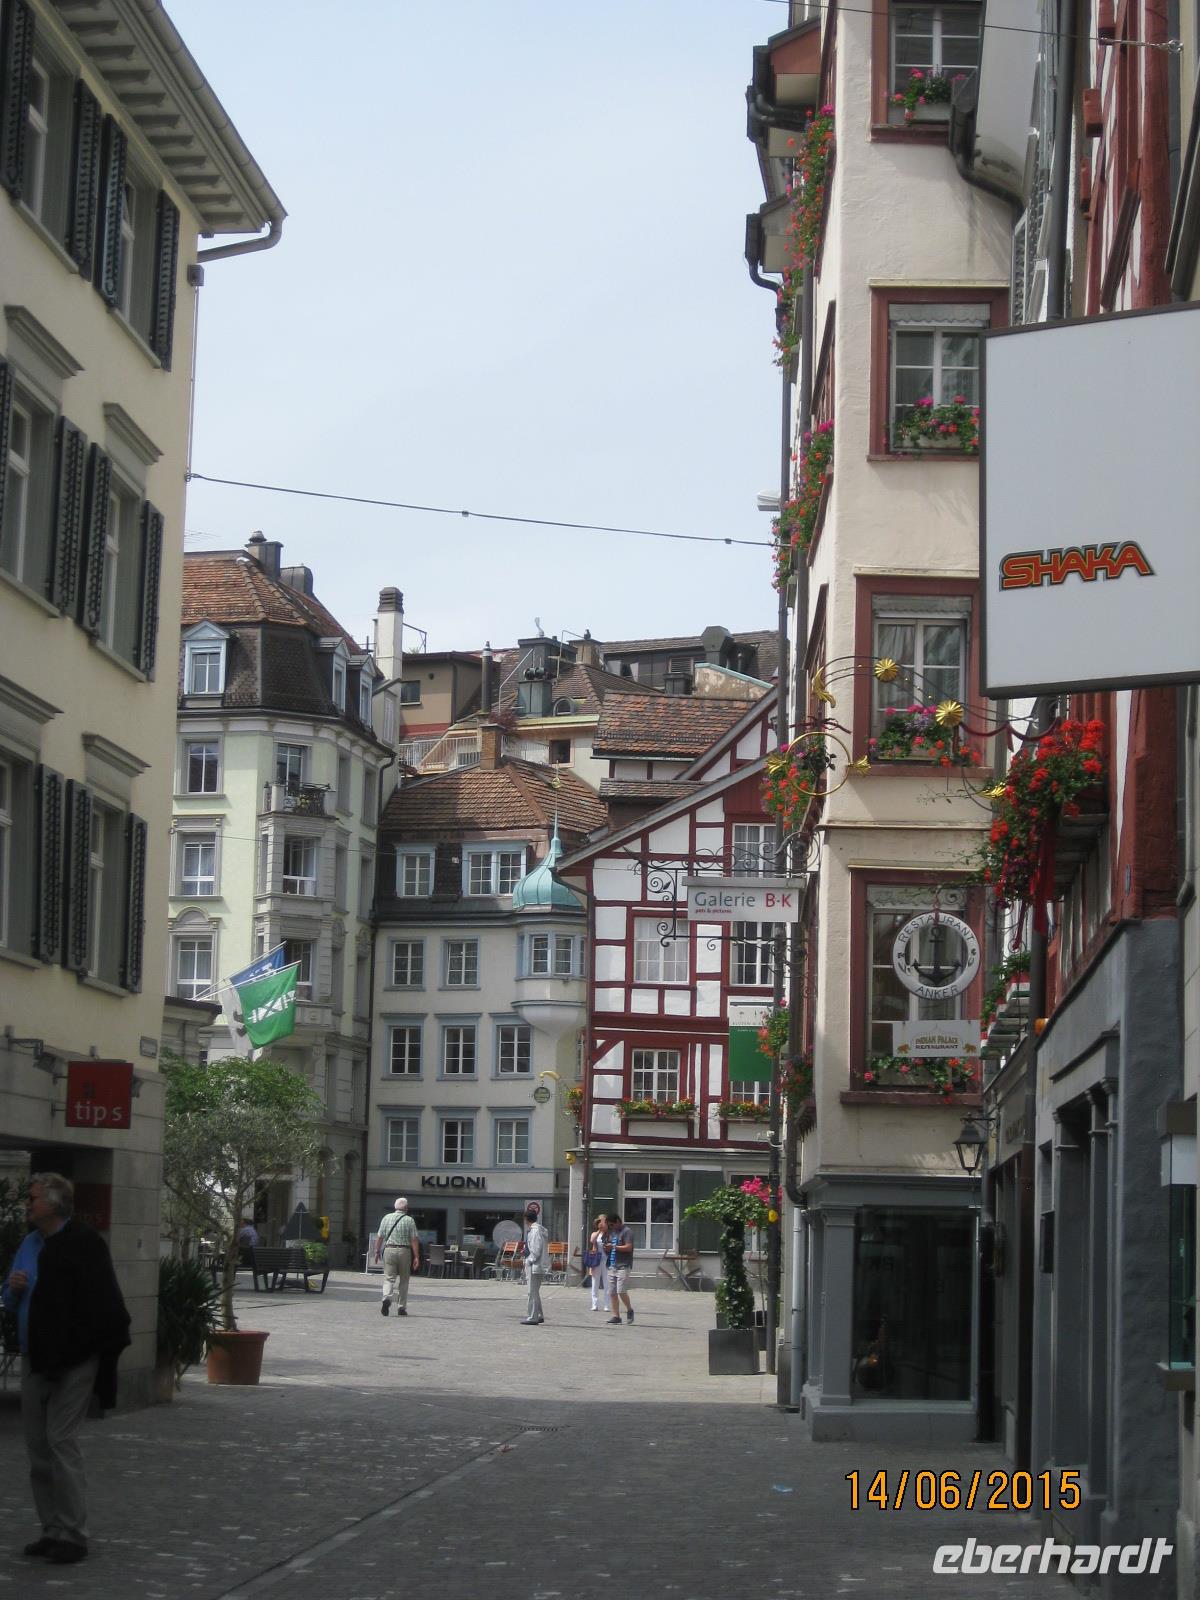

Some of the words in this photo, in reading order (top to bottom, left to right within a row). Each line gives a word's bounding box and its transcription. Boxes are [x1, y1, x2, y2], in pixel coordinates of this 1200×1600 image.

[999, 541, 1155, 591] SHAKA
[694, 892, 756, 907] Galerie
[898, 913, 975, 943] RESTAURANT
[916, 984, 959, 999] ANKER
[74, 1101, 122, 1125] tips
[421, 1175, 486, 1189] KUONI
